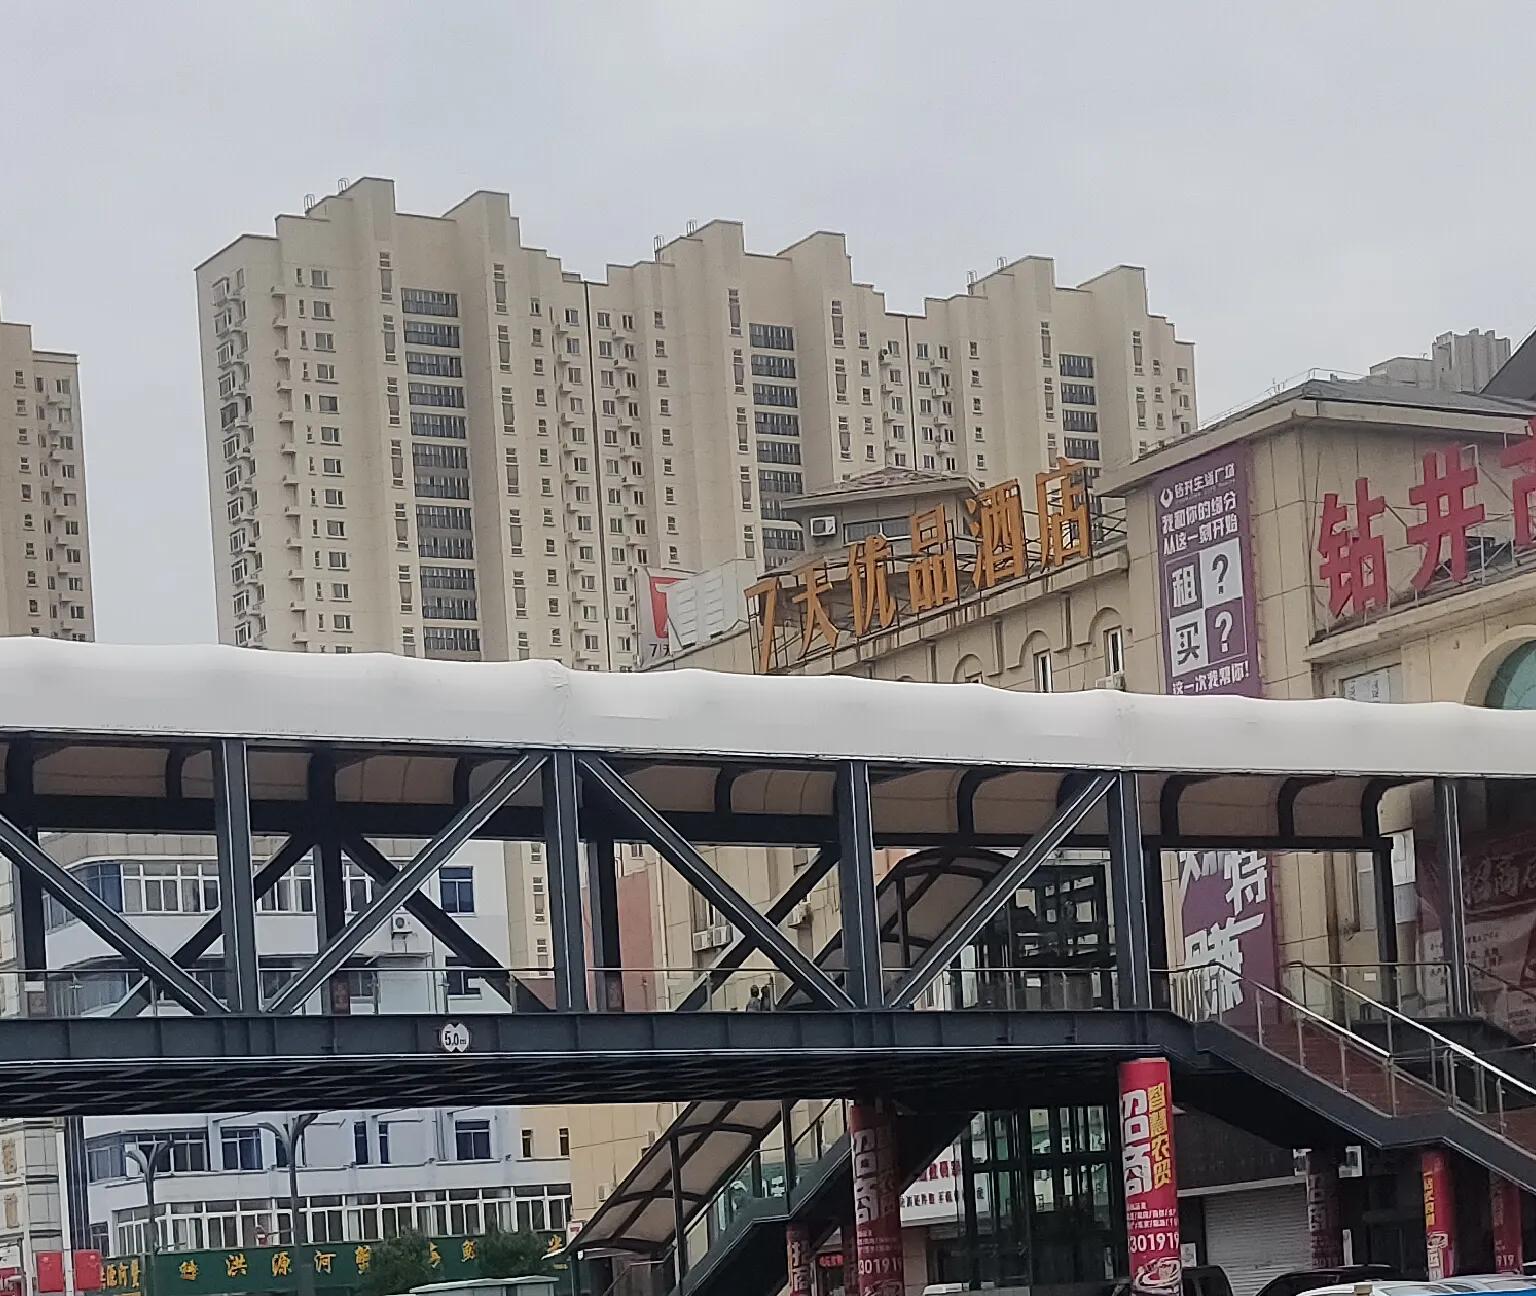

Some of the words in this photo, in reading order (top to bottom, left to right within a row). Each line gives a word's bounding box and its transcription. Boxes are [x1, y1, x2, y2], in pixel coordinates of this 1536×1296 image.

[1162, 491, 1237, 534] 我和你的缘分
[1164, 513, 1238, 555] 从这一刻开始
[744, 457, 1092, 672] 7天优品酒店
